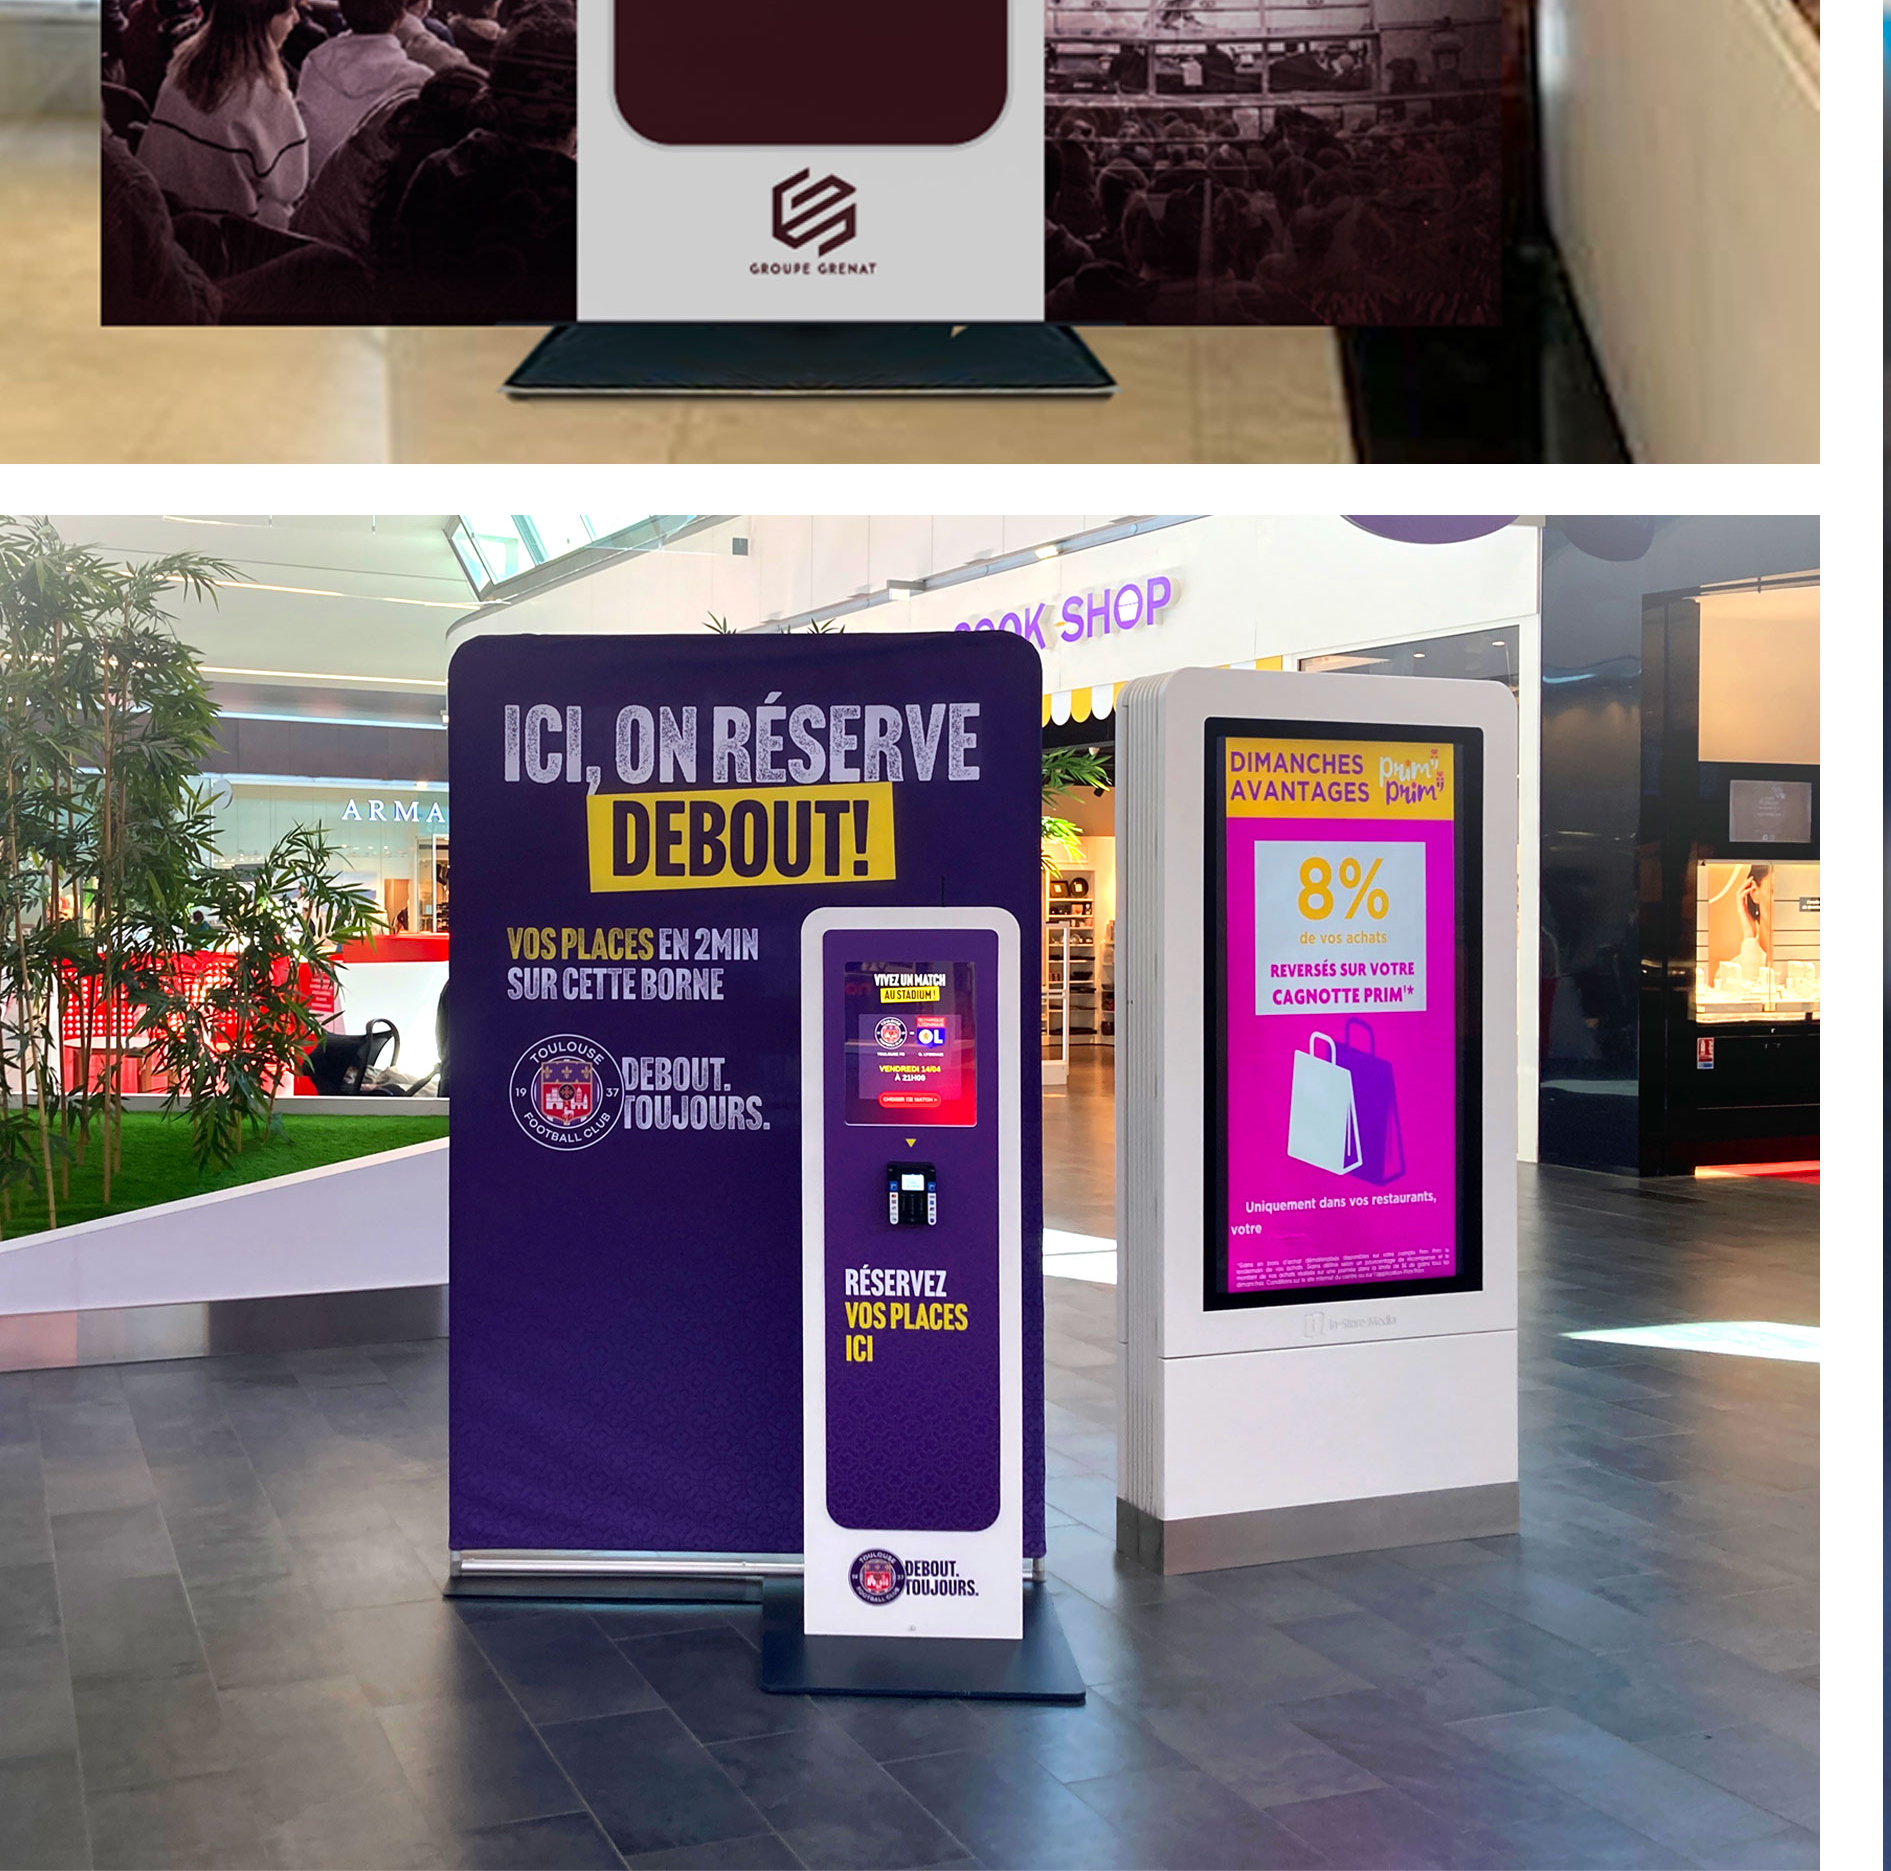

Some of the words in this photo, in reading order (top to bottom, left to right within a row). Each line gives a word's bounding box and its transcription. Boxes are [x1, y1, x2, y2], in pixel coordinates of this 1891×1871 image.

[749, 263, 811, 275] GROUPE
[818, 263, 877, 275] GRENAT
[1061, 576, 1171, 642] SHOP
[504, 703, 601, 795] ICI,
[616, 705, 697, 783] ON
[712, 691, 981, 783] RÉSERVE
[1230, 751, 1364, 775] DIMANCHES
[1230, 780, 1370, 803] AVANTAGES
[342, 799, 445, 823] ARMA
[612, 800, 870, 877] DEBOUT!
[1298, 856, 1389, 921] 8%
[507, 927, 557, 961] VOS
[560, 927, 654, 961] PLACES
[658, 927, 690, 961] EN
[694, 928, 760, 962] 2MIN
[1299, 931, 1316, 945] de
[1320, 933, 1342, 944] vos
[1346, 930, 1387, 944] achats
[874, 974, 900, 987] VIVEZ
[915, 974, 946, 987] MATCH
[1271, 959, 1336, 978] REVERSÉS
[1340, 963, 1366, 976] SUR
[1370, 962, 1415, 976] VOTRE
[507, 967, 557, 1000] SUR
[562, 967, 637, 1001] CETTE
[640, 968, 725, 1001] BORNE
[897, 990, 932, 1000] STADIUM
[1272, 987, 1360, 1005] CAGNOTTE
[529, 1041, 605, 1066] TOULOUSE
[623, 1056, 732, 1092] DEBOUT.
[921, 1065, 941, 1073] 14/04
[515, 1087, 526, 1098] 19
[623, 1095, 771, 1131] TOUJOURS.
[523, 1110, 583, 1143] FOOTBALL
[584, 1111, 612, 1141] CLUB
[1246, 1197, 1316, 1214] Uniquement
[1319, 1195, 1346, 1209] dans
[1349, 1196, 1369, 1207] vos
[1372, 1190, 1437, 1205] restaurants,
[1231, 1223, 1262, 1236] votre
[845, 1264, 947, 1298] RÉSERVEZ
[845, 1301, 887, 1329] VOS
[890, 1302, 968, 1331] PLACES
[845, 1334, 873, 1362] ICI
[905, 1560, 960, 1578] DEBOUT.
[905, 1579, 979, 1597] TOUJOURS.
